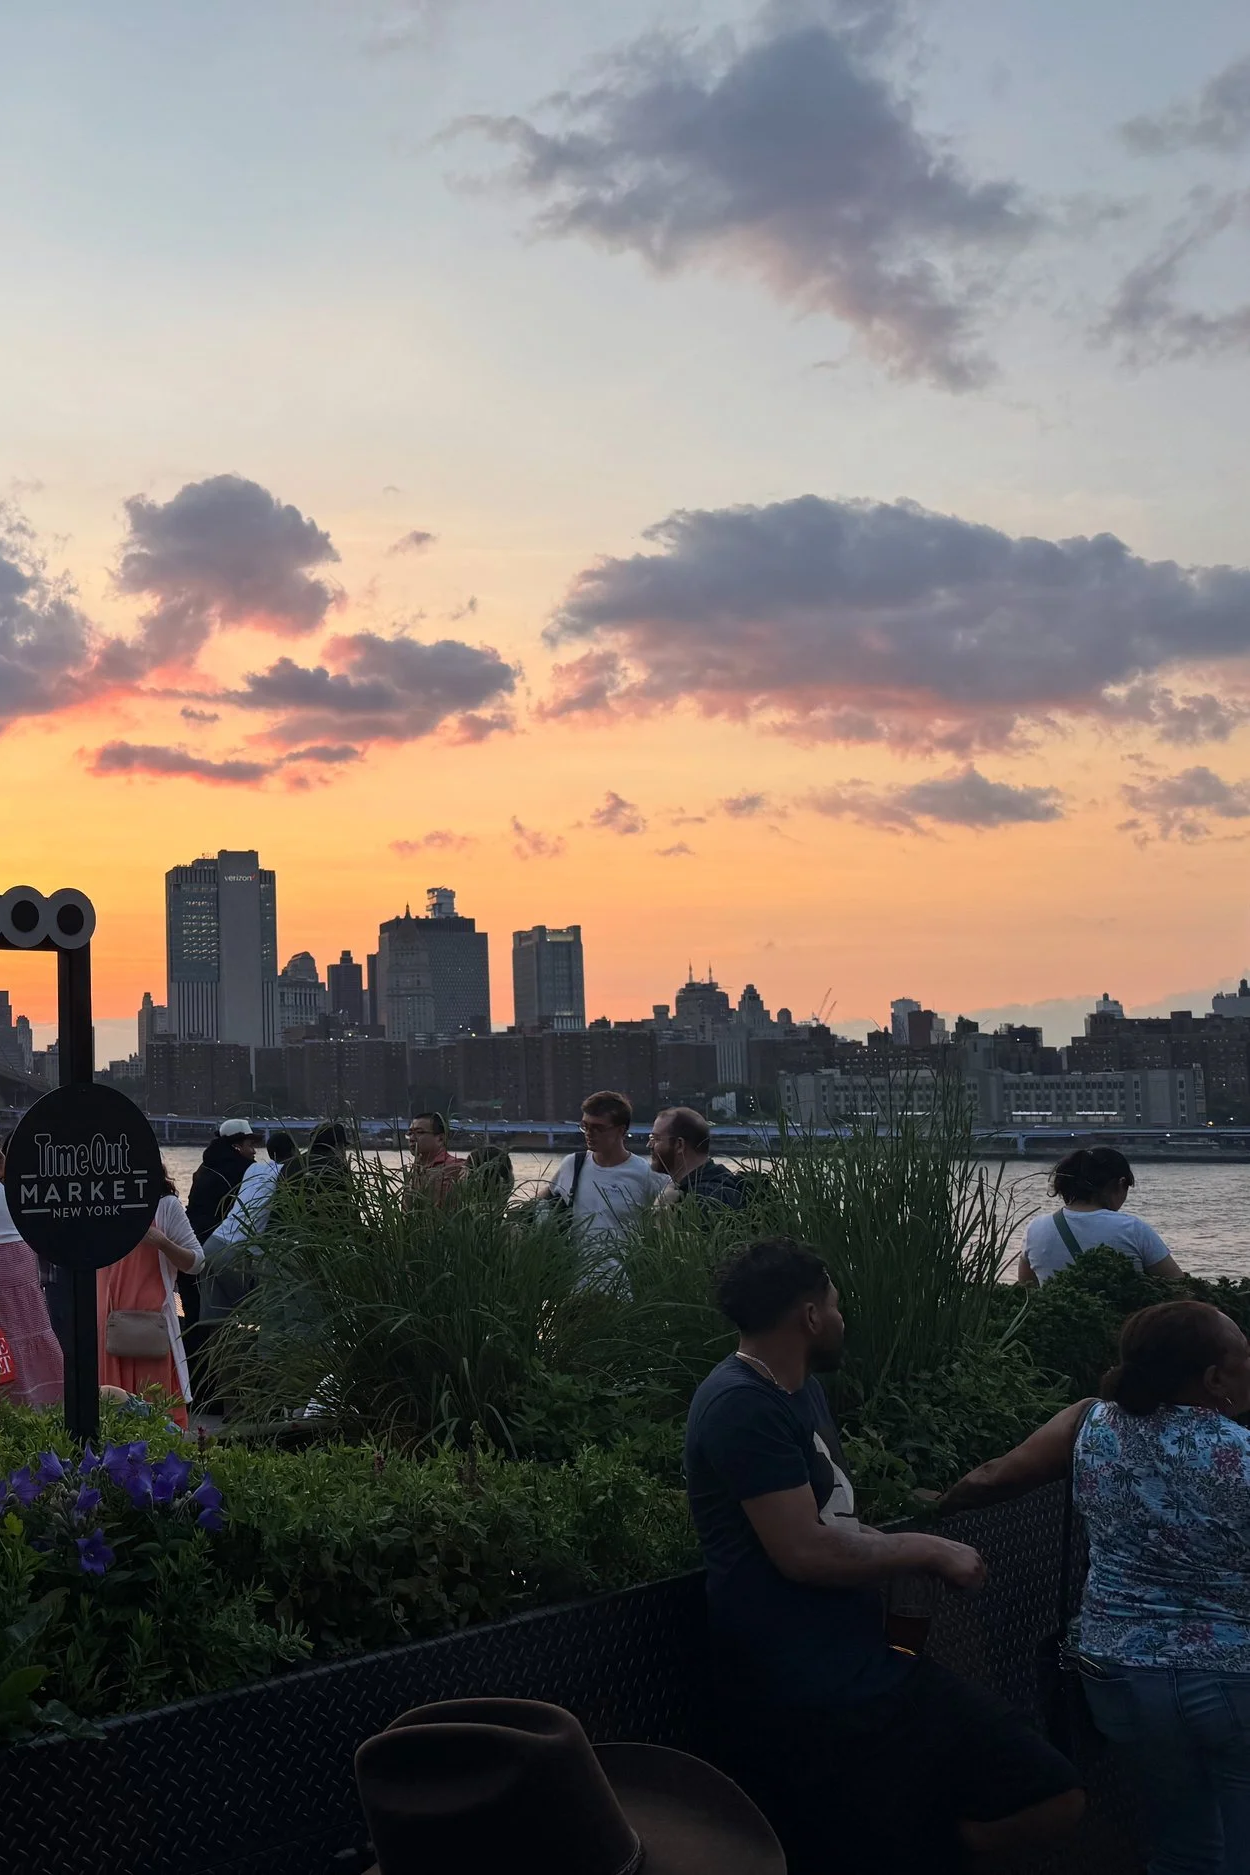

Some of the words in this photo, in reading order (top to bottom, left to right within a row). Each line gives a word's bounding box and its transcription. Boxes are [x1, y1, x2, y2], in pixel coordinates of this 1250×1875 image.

[224, 874, 252, 882] verizon
[20, 1178, 148, 1205] MARKET
[52, 1206, 82, 1219] NEW
[85, 1204, 121, 1217] YORK
